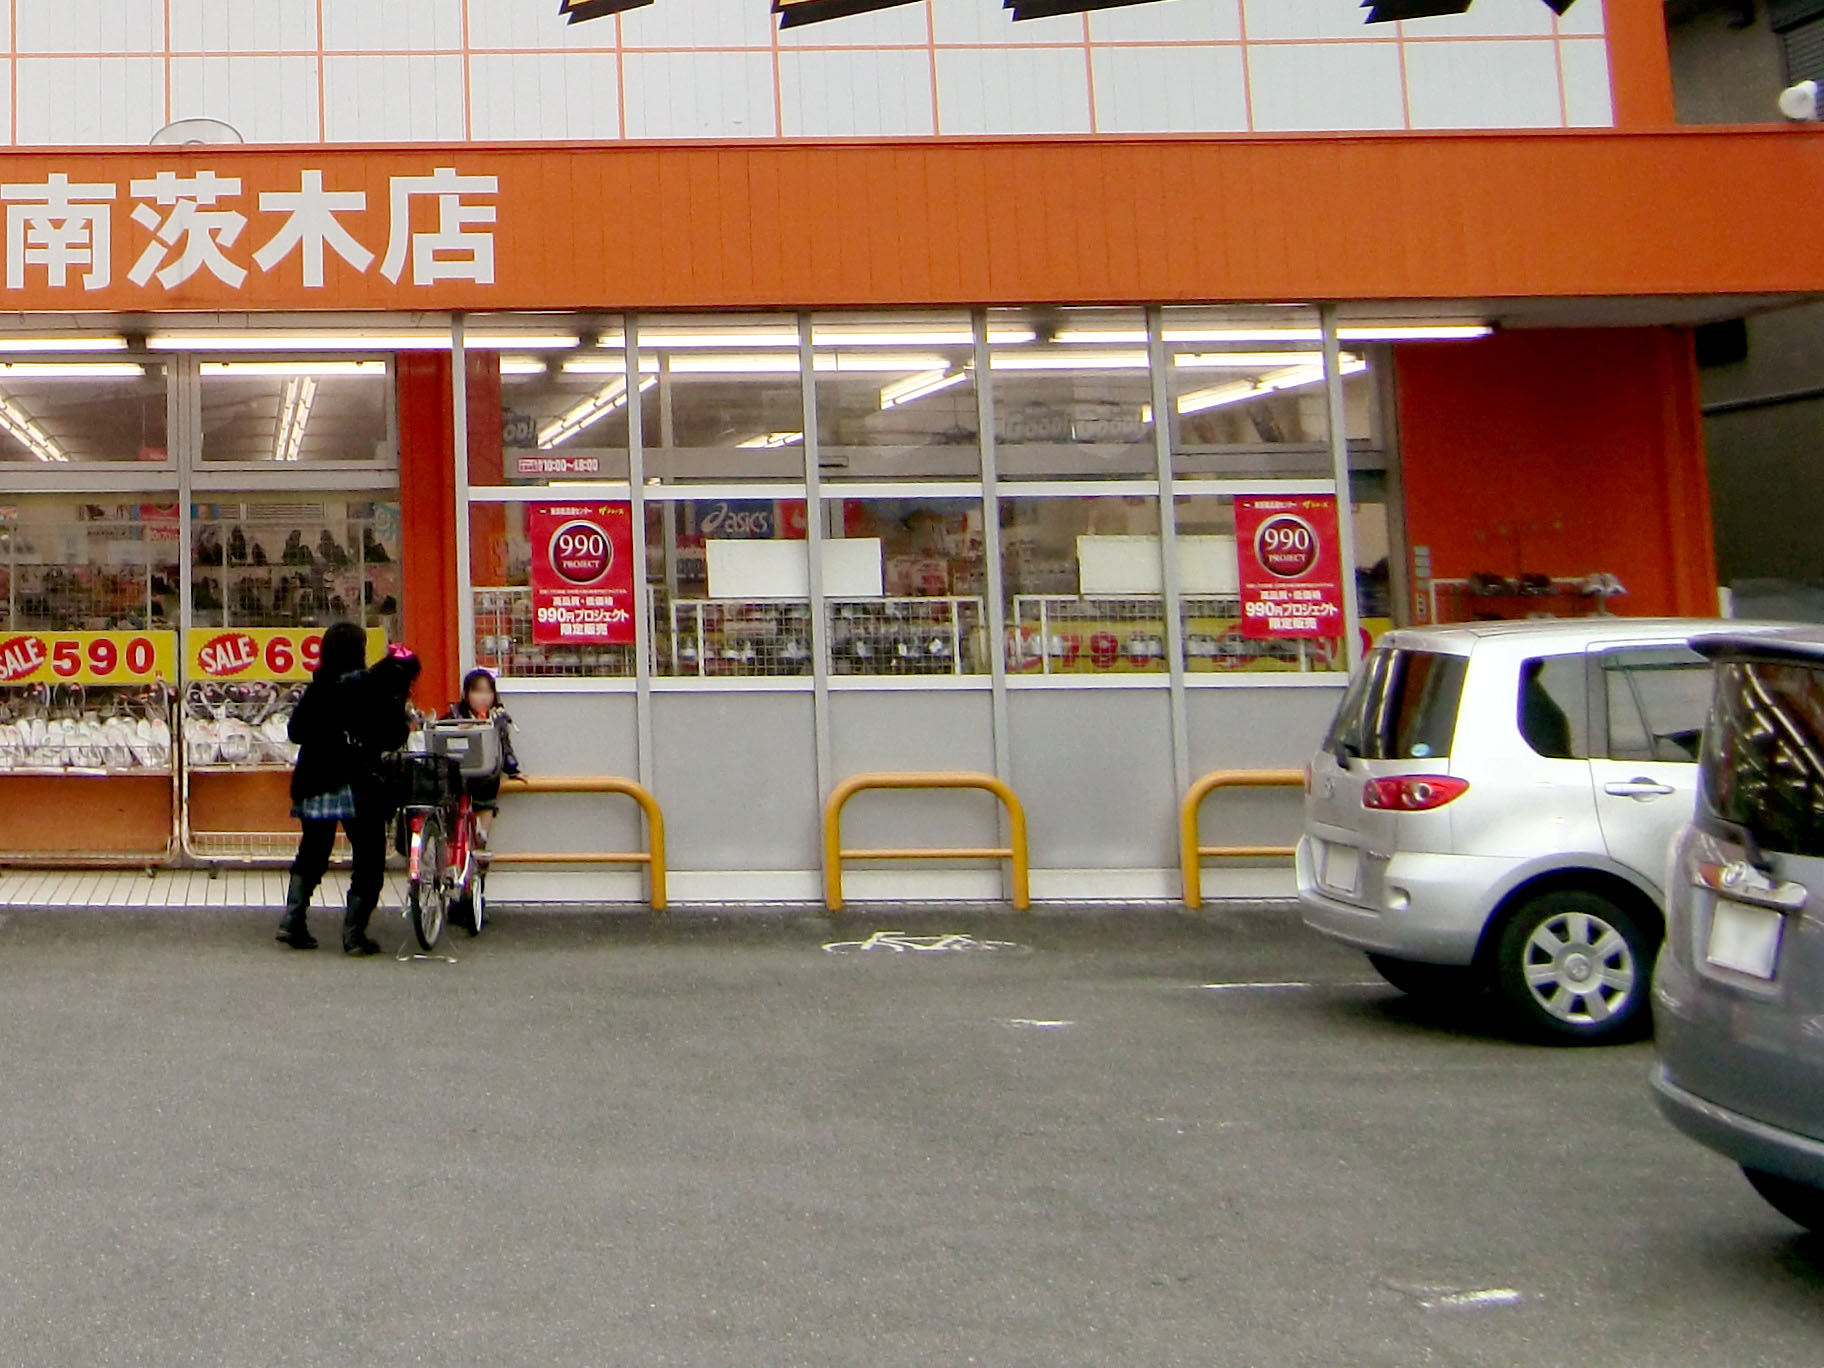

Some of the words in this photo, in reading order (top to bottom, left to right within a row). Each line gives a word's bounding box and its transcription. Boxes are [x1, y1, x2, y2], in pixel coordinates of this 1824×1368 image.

[559, 534, 603, 557] 990
[1264, 528, 1310, 550] 990
[562, 559, 601, 569] PROJECT
[1268, 553, 1306, 562] PROJECT
[537, 607, 630, 623] 990円プロジェクト
[51, 637, 156, 677] 590
[198, 636, 257, 677] SALE
[265, 635, 323, 674] 69
